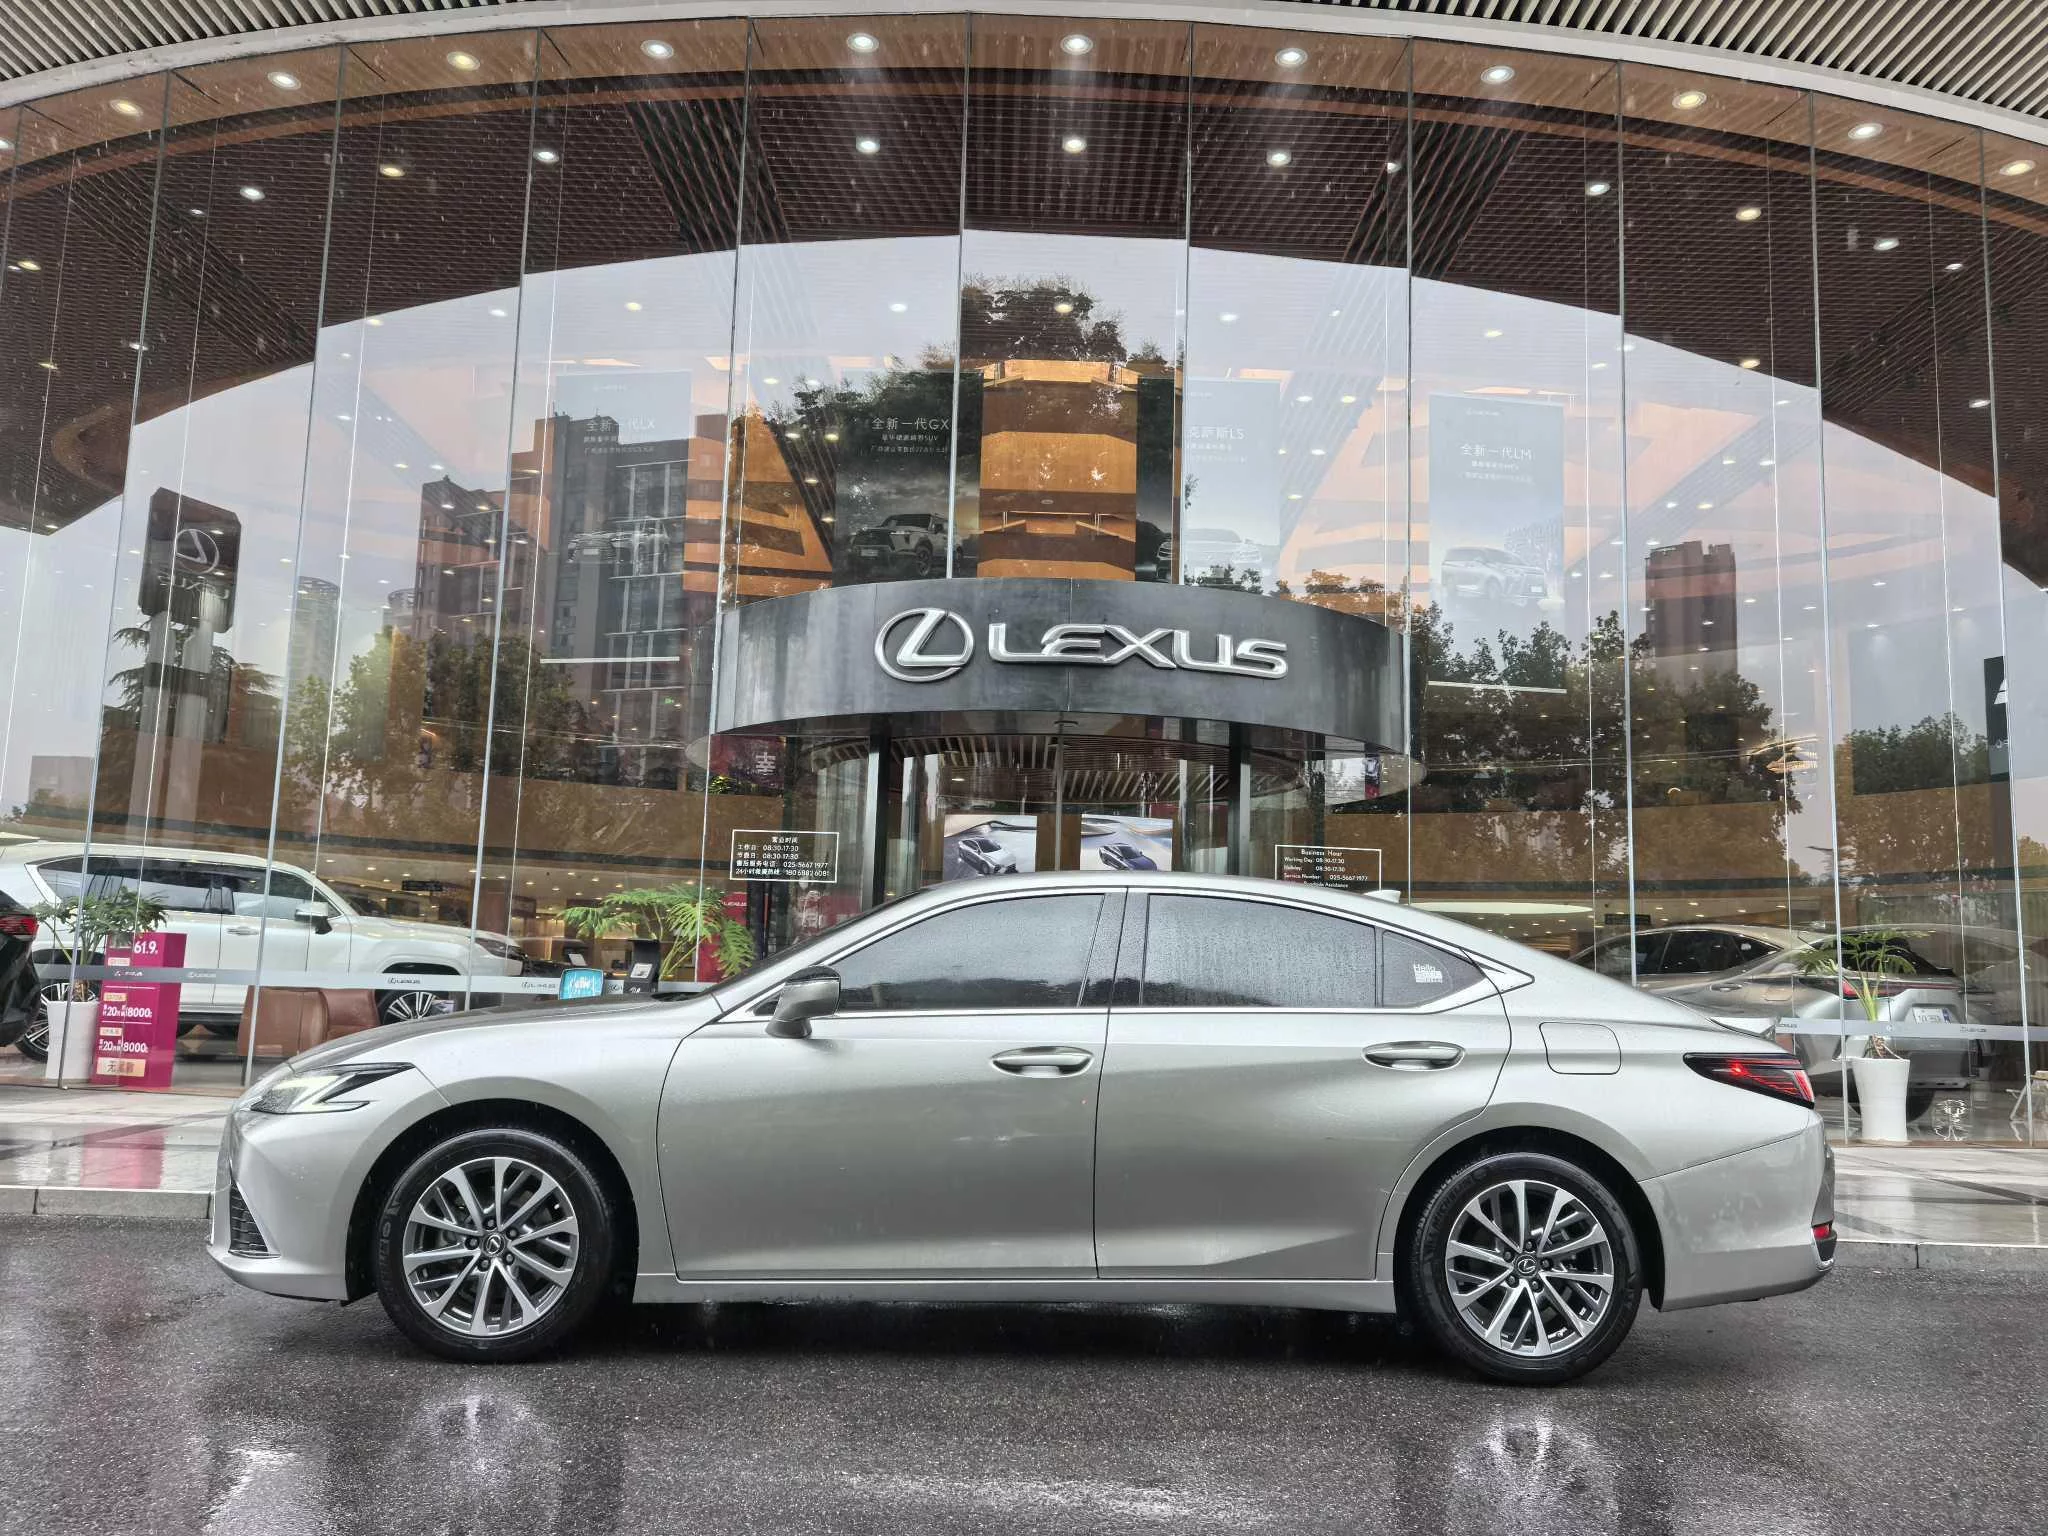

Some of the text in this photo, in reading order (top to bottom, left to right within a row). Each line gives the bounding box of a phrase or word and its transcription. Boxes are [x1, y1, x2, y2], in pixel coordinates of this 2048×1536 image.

[871, 417, 951, 431] 全新一代GX
[1181, 426, 1247, 441] 克萨斯LS
[1460, 443, 1532, 461] 全新一代LM
[988, 621, 1288, 680] LEXUS
